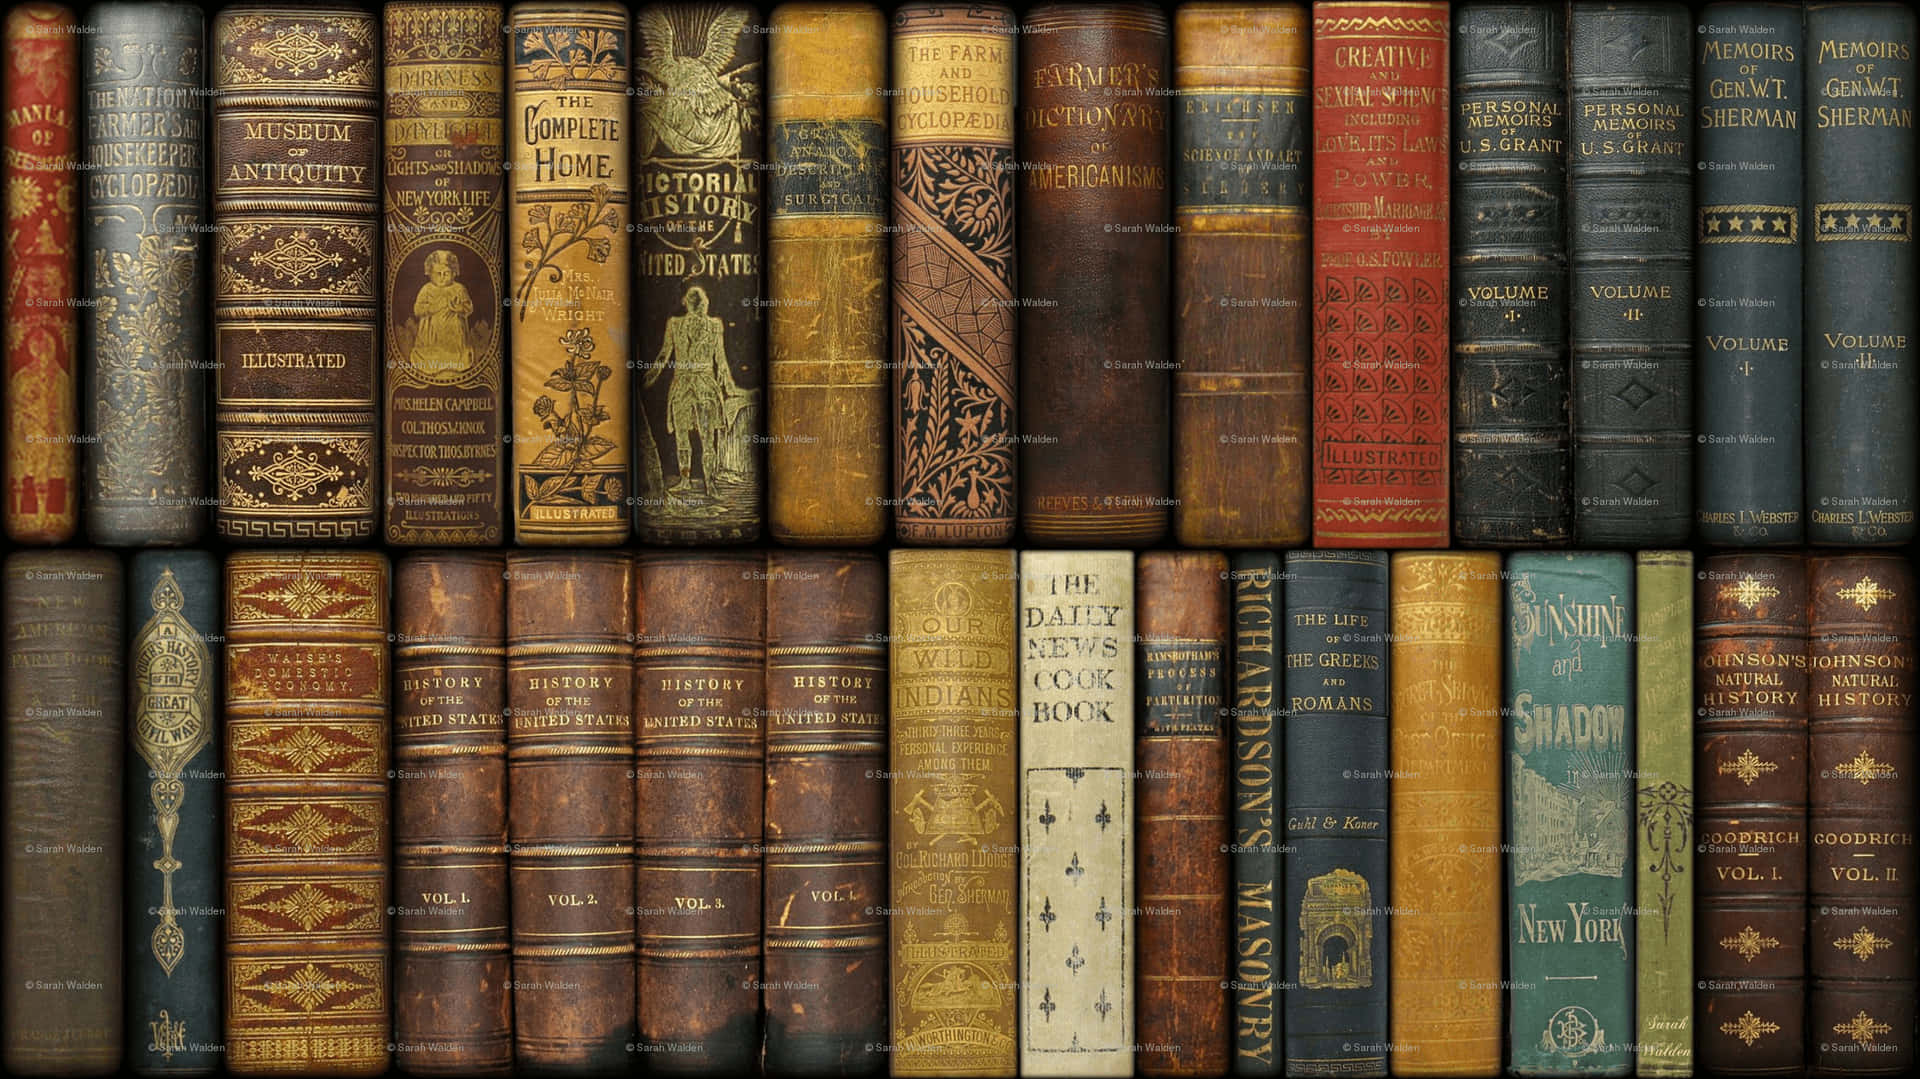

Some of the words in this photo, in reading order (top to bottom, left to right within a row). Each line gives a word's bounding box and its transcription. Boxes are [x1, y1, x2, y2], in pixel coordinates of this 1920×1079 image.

[908, 46, 941, 62] THE
[949, 44, 1003, 64] FARM
[1335, 45, 1432, 68] CREATIVE
[1702, 41, 1795, 64] MEMOIRS
[1818, 40, 1910, 64] MEMOIRS
[940, 67, 972, 79] AND
[1033, 62, 1160, 92] FARMER'S
[1739, 64, 1759, 75] OF
[1855, 64, 1874, 75] OF
[556, 96, 593, 108] THE
[897, 85, 1010, 105] HOUSEHOLD
[1461, 100, 1561, 116] PERSONAL
[1583, 103, 1685, 118] PERSONAL
[524, 99, 619, 145] COMPLETE
[1344, 113, 1420, 126] INCLUDING
[1467, 114, 1553, 128] MEMOIRS
[1592, 118, 1676, 131] MEMOIRS
[1700, 106, 1797, 129] SHERMAN
[1817, 105, 1912, 129] SHERMAN
[32, 129, 53, 146] OF
[245, 123, 352, 142] MUSEUM
[1627, 131, 1642, 140] OF
[1090, 142, 1109, 153] OF
[1368, 134, 1397, 152] ITS
[288, 148, 308, 156] OF
[387, 160, 429, 176] LIGHTS
[534, 147, 615, 183] HOME
[226, 164, 367, 184] ANTIQUITY
[435, 178, 450, 187] OF
[397, 191, 423, 206] NEW
[426, 191, 461, 206] YORK
[463, 191, 491, 206] LIFE
[1468, 285, 1550, 300] VOLUME
[1589, 285, 1672, 300] VOLUME
[1706, 335, 1789, 351] VOLUME
[1824, 333, 1907, 349] VOLUME
[241, 353, 346, 369] ILLUSTRATED
[1327, 446, 1439, 466] ILLUSTRATED
[532, 507, 616, 520] ILLUSTRATED
[1050, 574, 1101, 596] THE
[1025, 606, 1121, 629] DAILY
[1511, 573, 1625, 648] SUNSHINE
[922, 617, 984, 635] OUR
[1294, 614, 1329, 626] THE
[1333, 614, 1369, 627] LIFE
[1326, 635, 1340, 644] OF
[1027, 638, 1118, 660] NEWS
[268, 653, 343, 664] WALSH'S
[914, 649, 992, 669] WILD
[1287, 653, 1314, 668] THE
[1319, 653, 1379, 670] GREEKS
[1552, 639, 1583, 681] and
[1034, 669, 1114, 692] COOK
[1148, 668, 1216, 679] PROCESS
[1715, 673, 1783, 686] NATURAL
[1832, 674, 1898, 687] NATURAL
[403, 677, 483, 691] HISTORY
[528, 677, 613, 690] HISTORY
[662, 678, 744, 691] HISTORY
[793, 676, 872, 690] HISTORY
[1323, 678, 1346, 686] AND
[148, 695, 187, 709] GREAT
[420, 696, 435, 706] OF
[437, 695, 463, 706] THE
[546, 696, 561, 707] OF
[565, 696, 591, 707] THE
[678, 697, 694, 708] OF
[697, 697, 723, 708] THE
[814, 694, 830, 704] OF
[832, 694, 857, 704] THE
[896, 685, 1010, 709] INDIANS
[1291, 696, 1373, 712] ROMANS
[1704, 691, 1798, 705] HISTORY
[1818, 693, 1913, 706] HISTORY
[1033, 701, 1114, 723] BOOK
[1236, 567, 1273, 849] RICHARDSON'S
[514, 714, 570, 729] UNITED
[575, 713, 630, 727] STATES
[645, 714, 701, 729] UNITED
[706, 714, 759, 730] STATES
[776, 713, 837, 726] UNITED
[1514, 689, 1625, 752] SHADOW
[917, 757, 956, 771] AMONG
[1288, 816, 1317, 831] Guhl
[1322, 816, 1338, 829] &
[1701, 832, 1799, 845] GOODRICH
[1814, 833, 1912, 846] GOODRICH
[1716, 866, 1764, 881] VOL.
[1832, 866, 1879, 881] VOL.
[422, 893, 457, 905] VOL.
[549, 894, 584, 907] VOL.
[587, 894, 598, 906] 2.
[675, 897, 711, 910] VOL.
[1237, 880, 1273, 1065] MASONRY
[1647, 1015, 1689, 1031] Sarah
